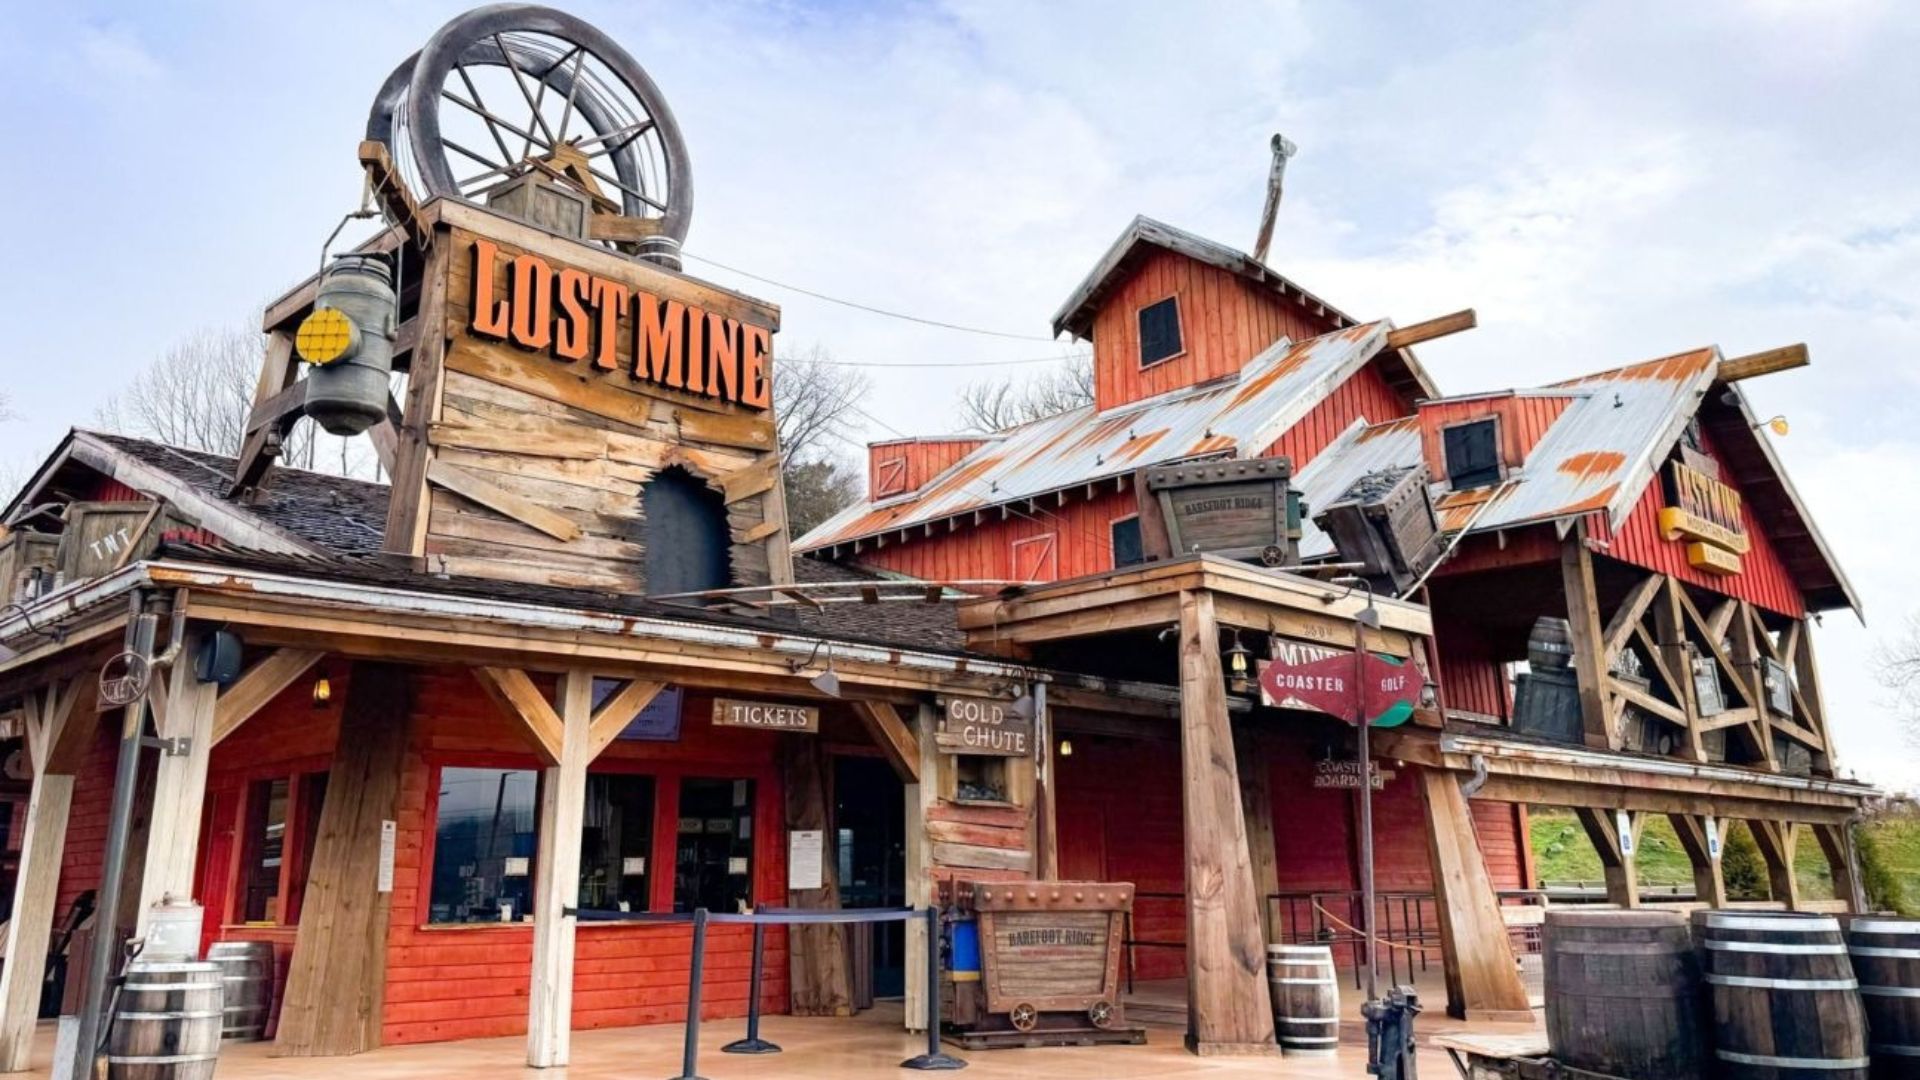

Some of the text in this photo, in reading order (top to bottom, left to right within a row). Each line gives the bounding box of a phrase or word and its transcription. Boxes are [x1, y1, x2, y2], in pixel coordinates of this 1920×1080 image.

[471, 239, 769, 410] LOST MINE
[1185, 496, 1263, 515] BAREFOOT RIDGE
[89, 528, 131, 560] TNT
[1275, 673, 1344, 692] COASTER
[1381, 675, 1405, 692] GOLF
[732, 705, 808, 726] TICKETS
[951, 699, 1004, 725] GOLD
[963, 726, 1026, 752] CHUTE
[1008, 929, 1097, 947] BAREFOOT RIDGE
